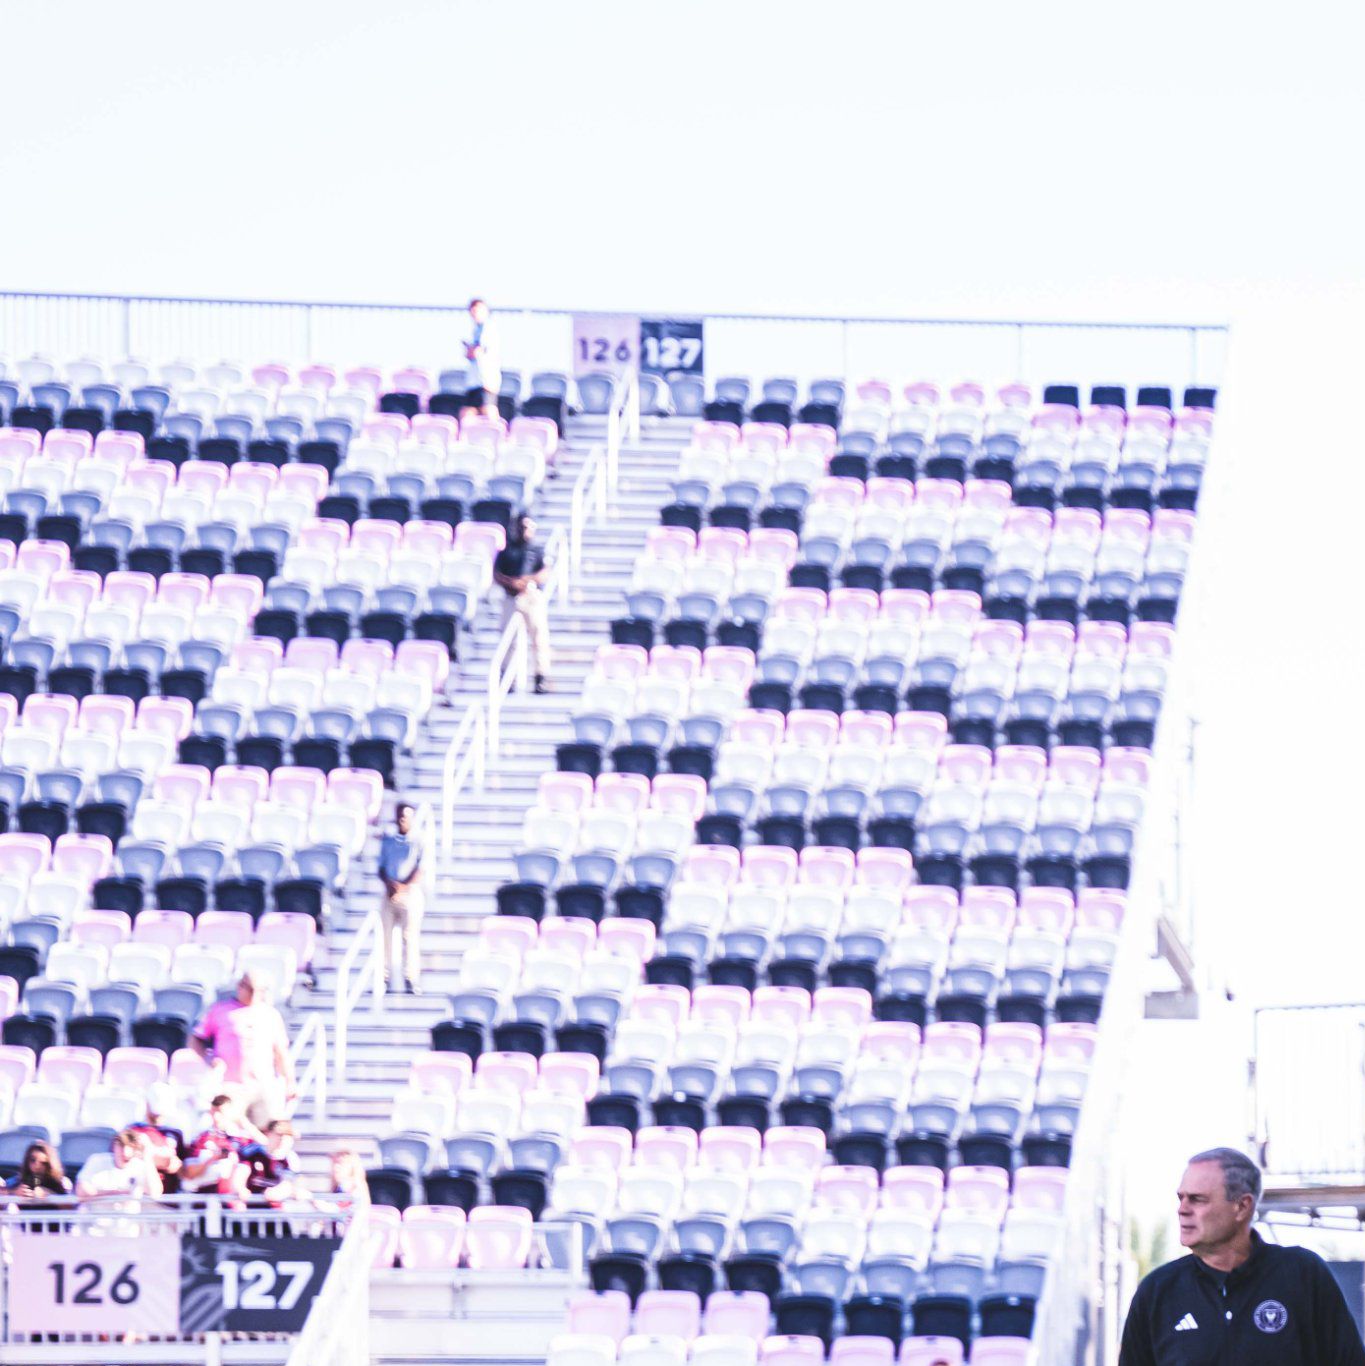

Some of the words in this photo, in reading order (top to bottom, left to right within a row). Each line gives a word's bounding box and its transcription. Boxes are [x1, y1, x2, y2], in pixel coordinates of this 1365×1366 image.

[579, 337, 631, 362] 126
[643, 336, 701, 369] 127
[48, 1261, 140, 1304] 126
[214, 1260, 314, 1310] 127
